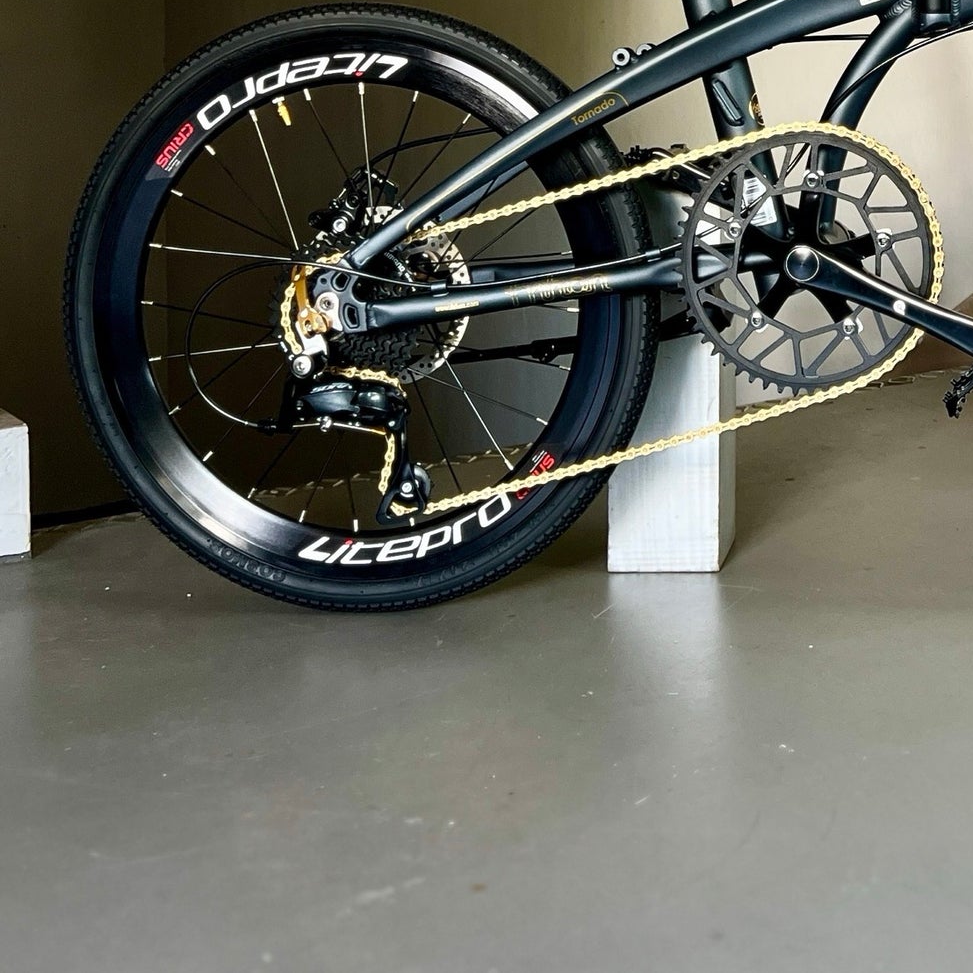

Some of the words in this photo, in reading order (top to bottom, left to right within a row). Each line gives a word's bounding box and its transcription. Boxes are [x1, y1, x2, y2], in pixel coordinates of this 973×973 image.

[196, 53, 409, 131] Litepro
[571, 98, 616, 126] Tornado
[155, 121, 195, 169] CRIUS
[298, 492, 512, 565] Litepro
